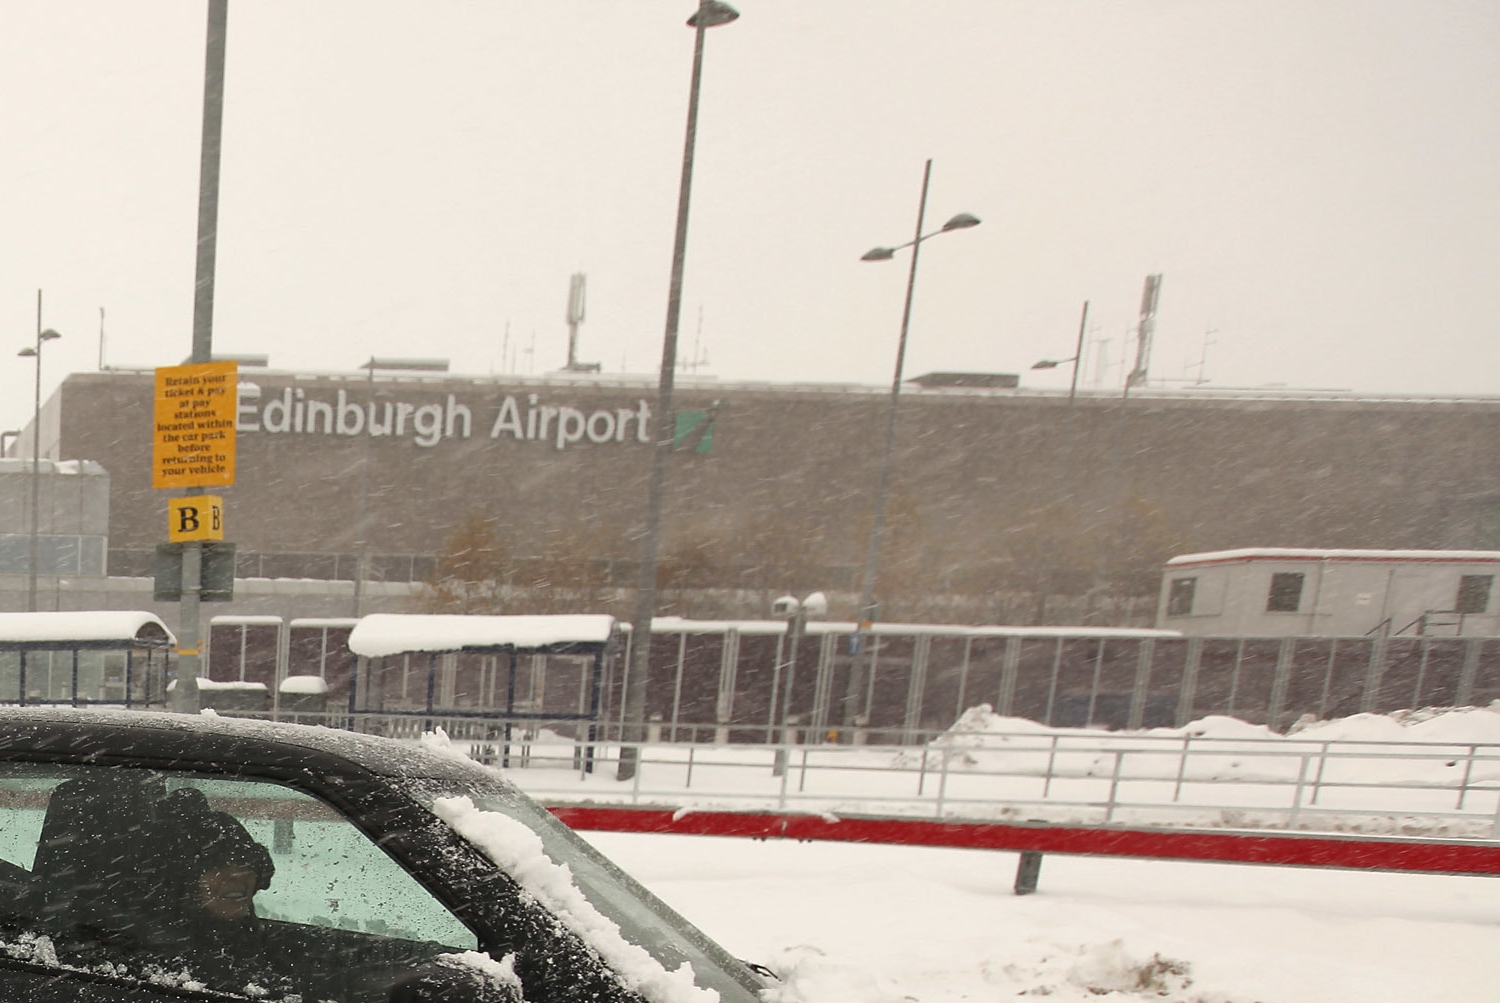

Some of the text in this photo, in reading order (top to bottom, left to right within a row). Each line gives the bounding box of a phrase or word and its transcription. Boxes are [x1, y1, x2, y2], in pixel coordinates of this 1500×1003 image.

[165, 375, 227, 386] Retain your
[164, 388, 194, 397] ticket
[197, 387, 204, 395] &
[179, 399, 211, 410] at pay
[174, 410, 216, 419] stations
[236, 386, 652, 450] Edinburgh Airport
[157, 419, 233, 431] located within
[163, 430, 226, 443] the car park
[177, 443, 211, 453] before
[162, 453, 226, 464] returning to
[162, 464, 226, 477] your vehicle
[177, 506, 200, 533] B
[212, 505, 220, 531] B
